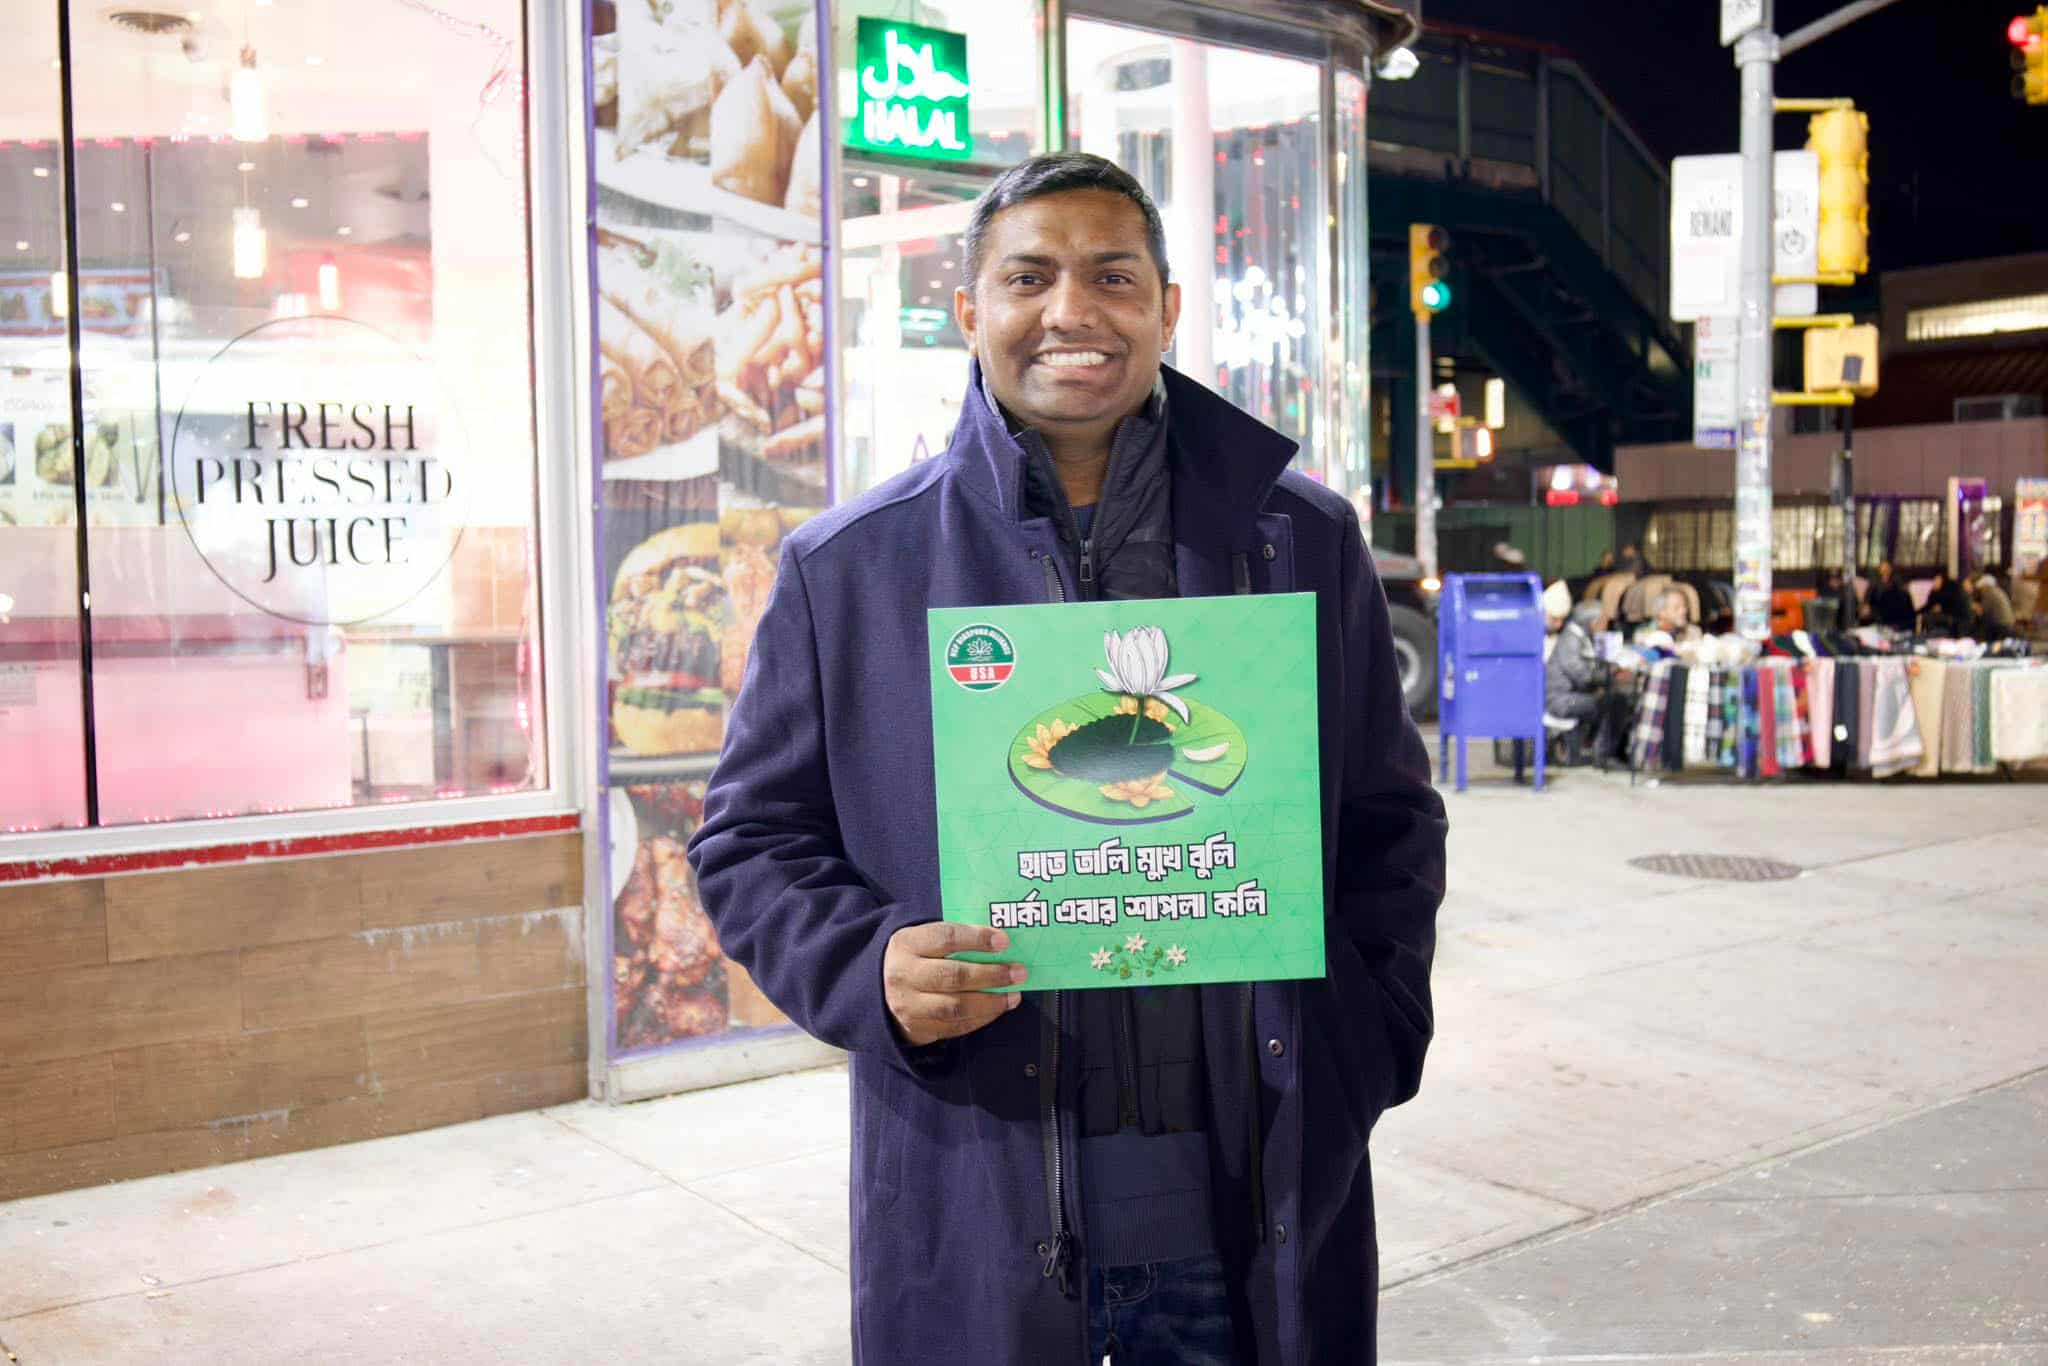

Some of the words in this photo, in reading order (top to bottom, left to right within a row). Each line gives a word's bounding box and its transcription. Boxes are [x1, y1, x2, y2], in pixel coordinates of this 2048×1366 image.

[862, 30, 969, 100] حلال
[864, 100, 966, 150] HALAL
[245, 401, 418, 450] FRESH
[196, 458, 452, 504] PRESSED
[263, 516, 409, 583] JUICE
[970, 666, 995, 681] USA
[1018, 850, 1067, 882] হাতে
[1073, 837, 1130, 874] তালি
[1136, 845, 1182, 880] মুখে
[1187, 832, 1235, 879] বুলি
[990, 888, 1049, 928] মার্কা
[1054, 896, 1117, 926] এবার
[1123, 892, 1206, 921] শাপলা
[1212, 879, 1267, 916] কলি
